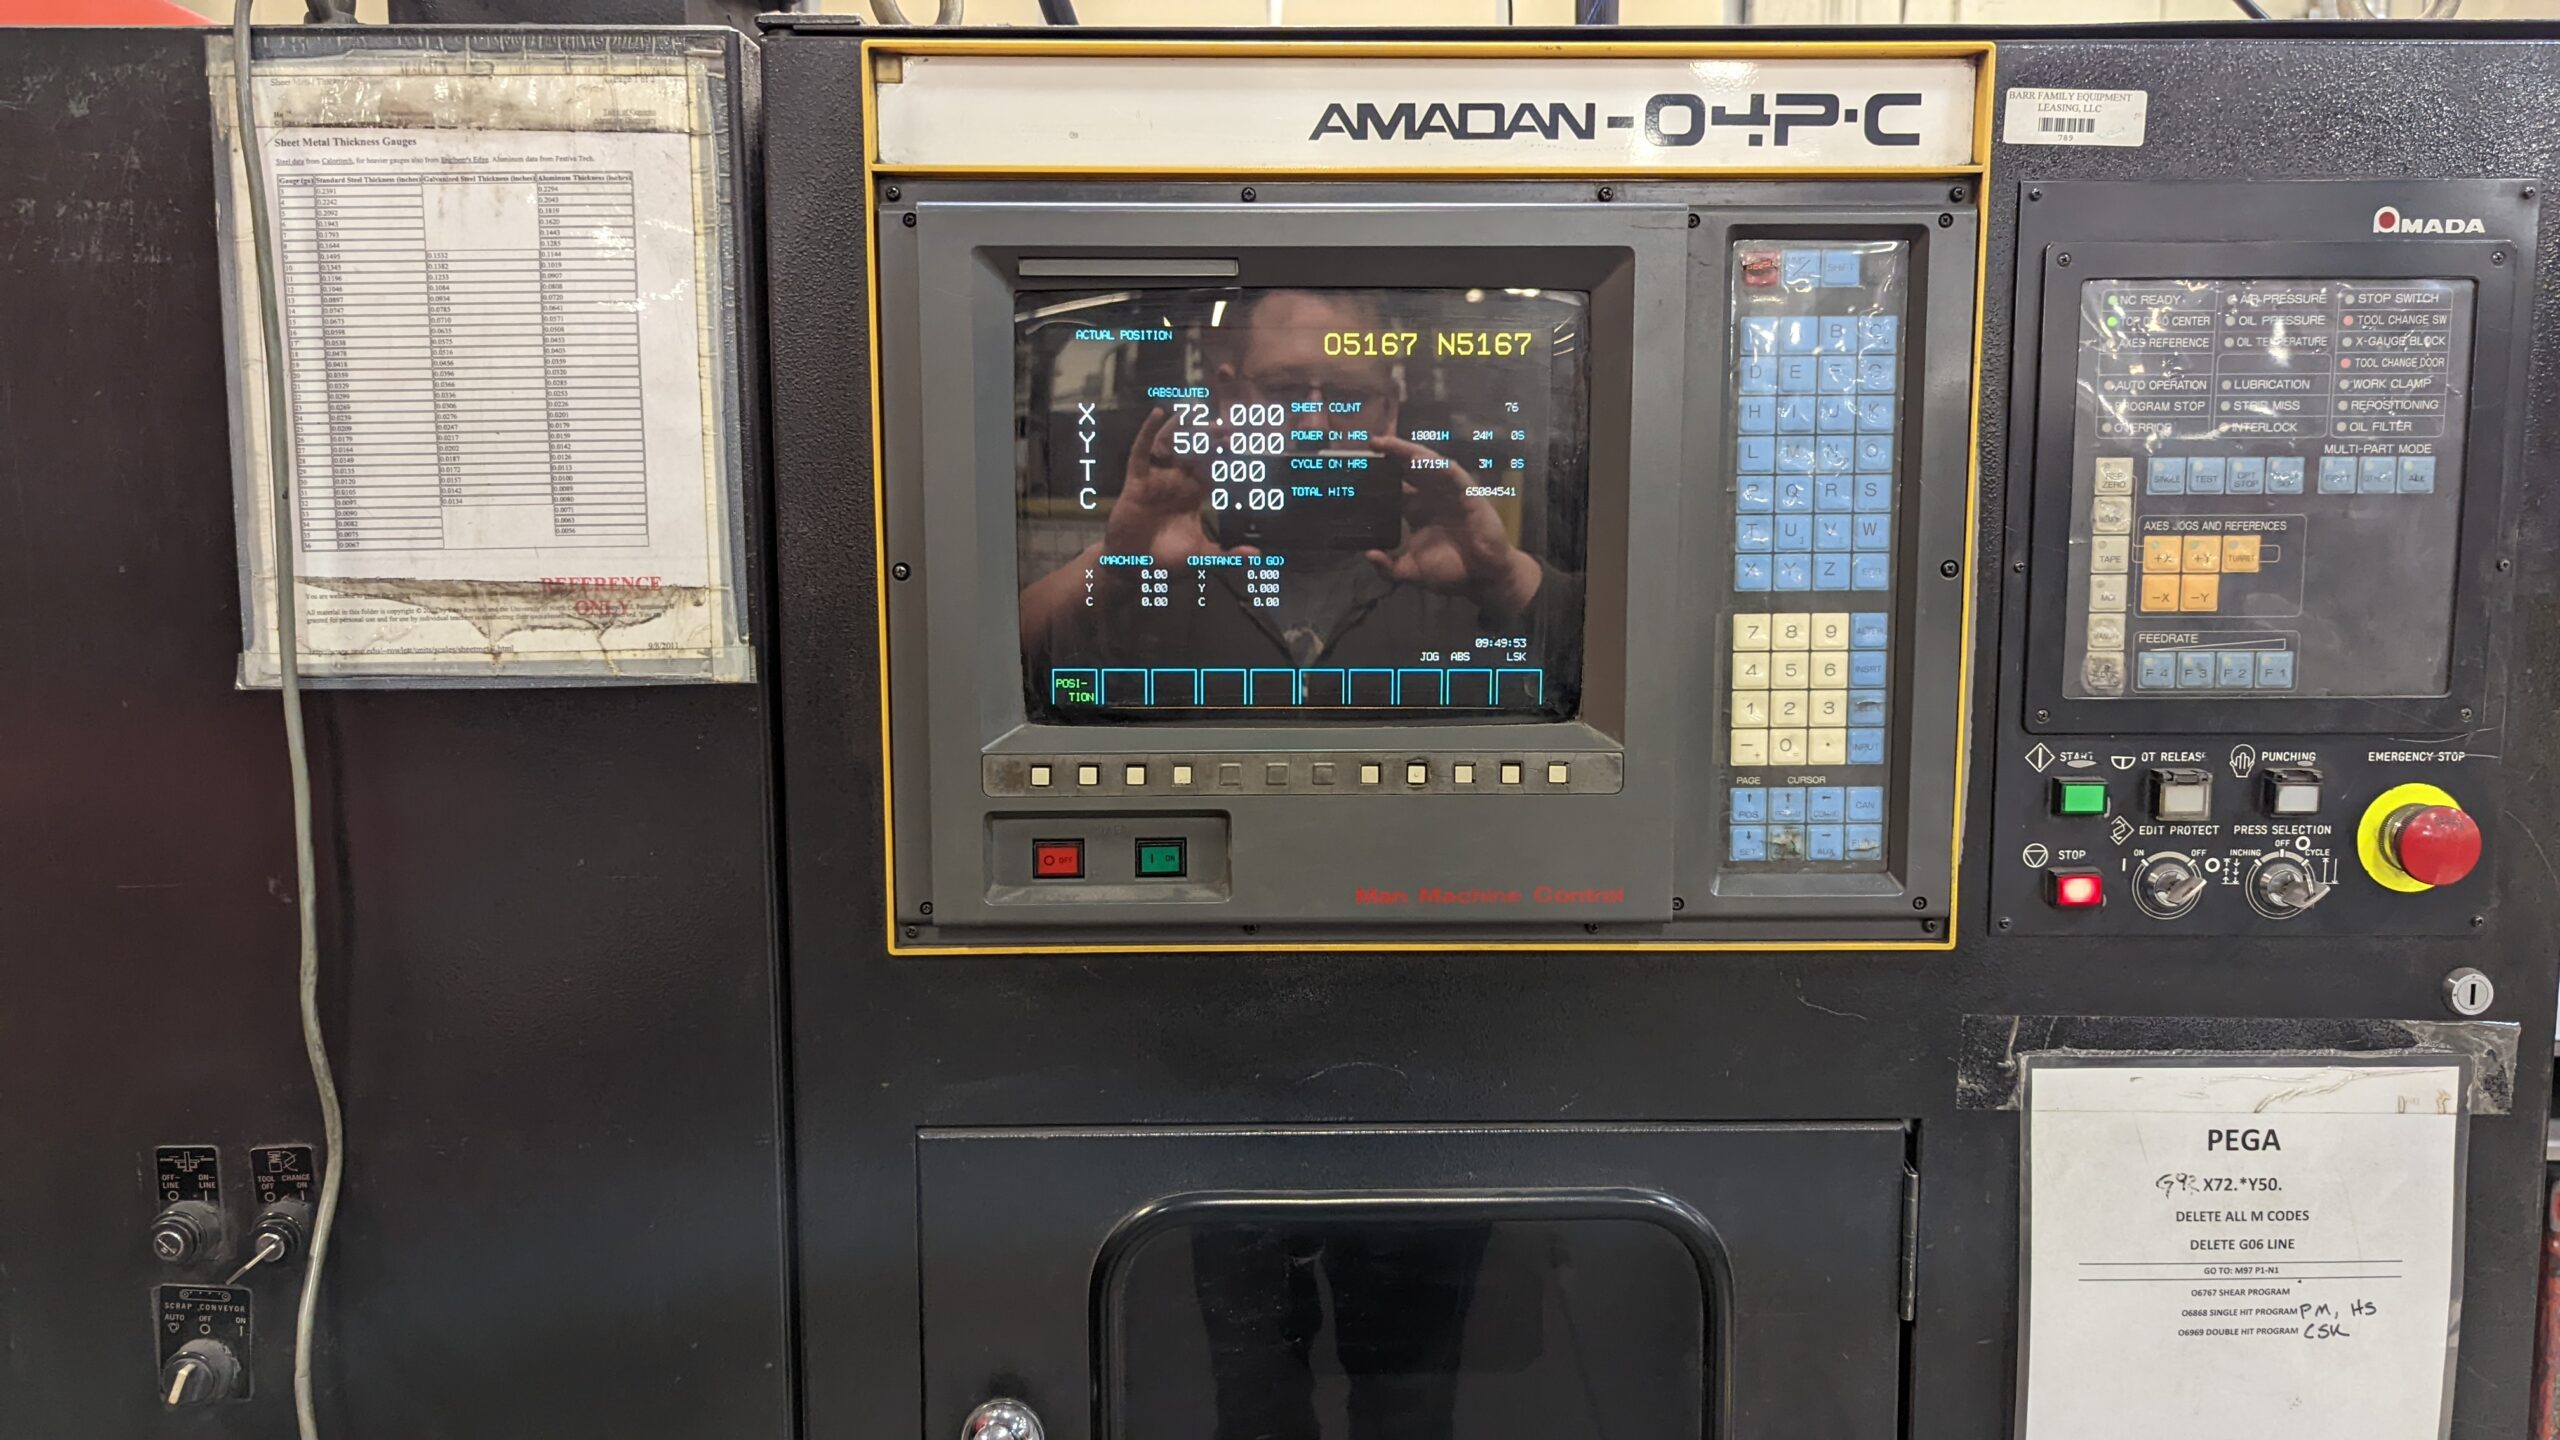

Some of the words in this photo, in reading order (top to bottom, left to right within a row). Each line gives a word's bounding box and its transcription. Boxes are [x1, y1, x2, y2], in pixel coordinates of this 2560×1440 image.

[2009, 91, 2035, 99] BARR
[2038, 92, 2074, 100] FAMILY
[2077, 93, 2132, 102] EQUIPMENT
[2038, 104, 2081, 113] LEASING,
[275, 139, 299, 147] Sheet
[302, 138, 330, 146] Metal
[332, 137, 380, 146] Thickness
[382, 137, 417, 146] Gauges
[2373, 206, 2485, 233] AMADA
[2120, 296, 2137, 305] NC
[2141, 295, 2181, 305] READY
[2263, 294, 2327, 304] PRESSURE
[2358, 294, 2391, 303] STOP
[2395, 293, 2438, 303] SWITCH
[2172, 317, 2210, 326] CENTER
[2358, 315, 2384, 324] TOOL
[2388, 315, 2429, 324] CHANGE
[2432, 314, 2447, 324] SW
[1076, 330, 1114, 340] ACTUAL
[1120, 331, 1172, 341] POSITION
[1438, 333, 1531, 355] N5167
[2119, 339, 2145, 348] AXES
[2149, 338, 2209, 348] REFERENCE
[2356, 336, 2406, 346] X-GAUGE
[2410, 336, 2446, 345] BLOCK
[2356, 358, 2379, 368] TOOL
[2382, 358, 2417, 367] CHANGE
[2421, 358, 2445, 367] DOOR
[2116, 381, 2145, 390] AUTO
[2150, 380, 2207, 390] OPERATION
[2234, 380, 2310, 389] LUBRICATION
[2353, 379, 2386, 388] WORK
[2391, 379, 2432, 388] CLAMP
[1148, 387, 1209, 398] (ABSOLUTE)
[1291, 403, 1323, 412] SHEET
[1329, 403, 1361, 412] COUNT
[1505, 403, 1519, 412] 76
[2351, 400, 2439, 410] REPOSITIONING
[1078, 403, 1095, 425] X
[1173, 404, 1284, 426] 72.000
[2232, 423, 2297, 432] INTERLOCK
[2350, 422, 2368, 431] OIL
[2372, 422, 2412, 431] FILTER
[1291, 431, 1323, 440] POWER
[1329, 431, 1342, 440] ON
[1348, 431, 1367, 440] HRS
[1411, 431, 1449, 440] 18001H
[1473, 431, 1492, 440] 24M
[1079, 431, 1095, 453] Y
[1173, 432, 1284, 454] 50.000
[2324, 444, 2394, 454] MULTI-PART
[2399, 444, 2432, 453] MODE
[1291, 459, 1323, 468] CYCLE
[1329, 459, 1342, 468] ON
[1348, 459, 1367, 468] HRS
[1411, 459, 1449, 468] 11719H
[1479, 459, 1492, 468] 3M
[1080, 459, 1096, 481] T
[1212, 461, 1265, 482] 000
[2195, 475, 2217, 483] TEST
[1291, 487, 1322, 496] TOTAL
[1329, 487, 1354, 496] HITS
[1080, 488, 1096, 509] C
[1212, 489, 1284, 510] 0.00
[2144, 521, 2169, 531] AXES
[2172, 521, 2199, 531] JOGS
[2202, 521, 2221, 531] AND
[2225, 521, 2287, 531] REFERENCES
[1100, 556, 1153, 566] (MACHINE)
[1187, 556, 1242, 566] (DISTANCE
[1248, 556, 1261, 565] TO
[1266, 556, 1284, 566] GO)
[1086, 570, 1093, 579] X
[1141, 570, 1168, 579] 0.00
[1198, 570, 1206, 579] X
[1248, 570, 1279, 579] 0.000
[1748, 625, 1759, 638] 7
[1785, 625, 1797, 638] 8
[1826, 625, 1836, 638] 9
[1475, 638, 1527, 648] 09:49:53
[2139, 634, 2198, 643] FEEDRATE
[1420, 652, 1439, 661] JOG
[1451, 652, 1470, 661] ABS
[1506, 652, 1526, 661] LSK
[1056, 679, 1087, 688] POSI-
[1069, 693, 1094, 702] TION
[2141, 753, 2155, 761] OT
[2262, 752, 2316, 762] PUNCHING
[2368, 752, 2434, 762] EMERGENCY
[2438, 752, 2465, 762] STOP
[1787, 776, 1826, 784] CURSOR
[2139, 826, 2165, 835] EDIT
[2170, 826, 2219, 835] PROTECT
[2234, 825, 2267, 834] PRESS
[2272, 825, 2331, 834] SELECTION
[2059, 850, 2086, 859] STOP
[1355, 887, 1408, 905] Man
[1418, 887, 1521, 904] Machine
[1534, 886, 1624, 903] Control
[2208, 1129, 2281, 1151] PEGA
[281, 1173, 310, 1181] CHANGE
[2176, 1212, 2221, 1222] DELETE
[2225, 1211, 2246, 1221] ALL
[2251, 1211, 2263, 1221] M
[2268, 1210, 2309, 1221] CODES
[2190, 1240, 2235, 1250] DELETE
[2240, 1240, 2263, 1250] G06
[2268, 1239, 2295, 1249] LINE
[2248, 1288, 2290, 1296] PROGRAM
[200, 1304, 245, 1312] CONVEYOR
[2351, 1299, 2376, 1316] HS
[2206, 1328, 2238, 1336] DOUBLE
